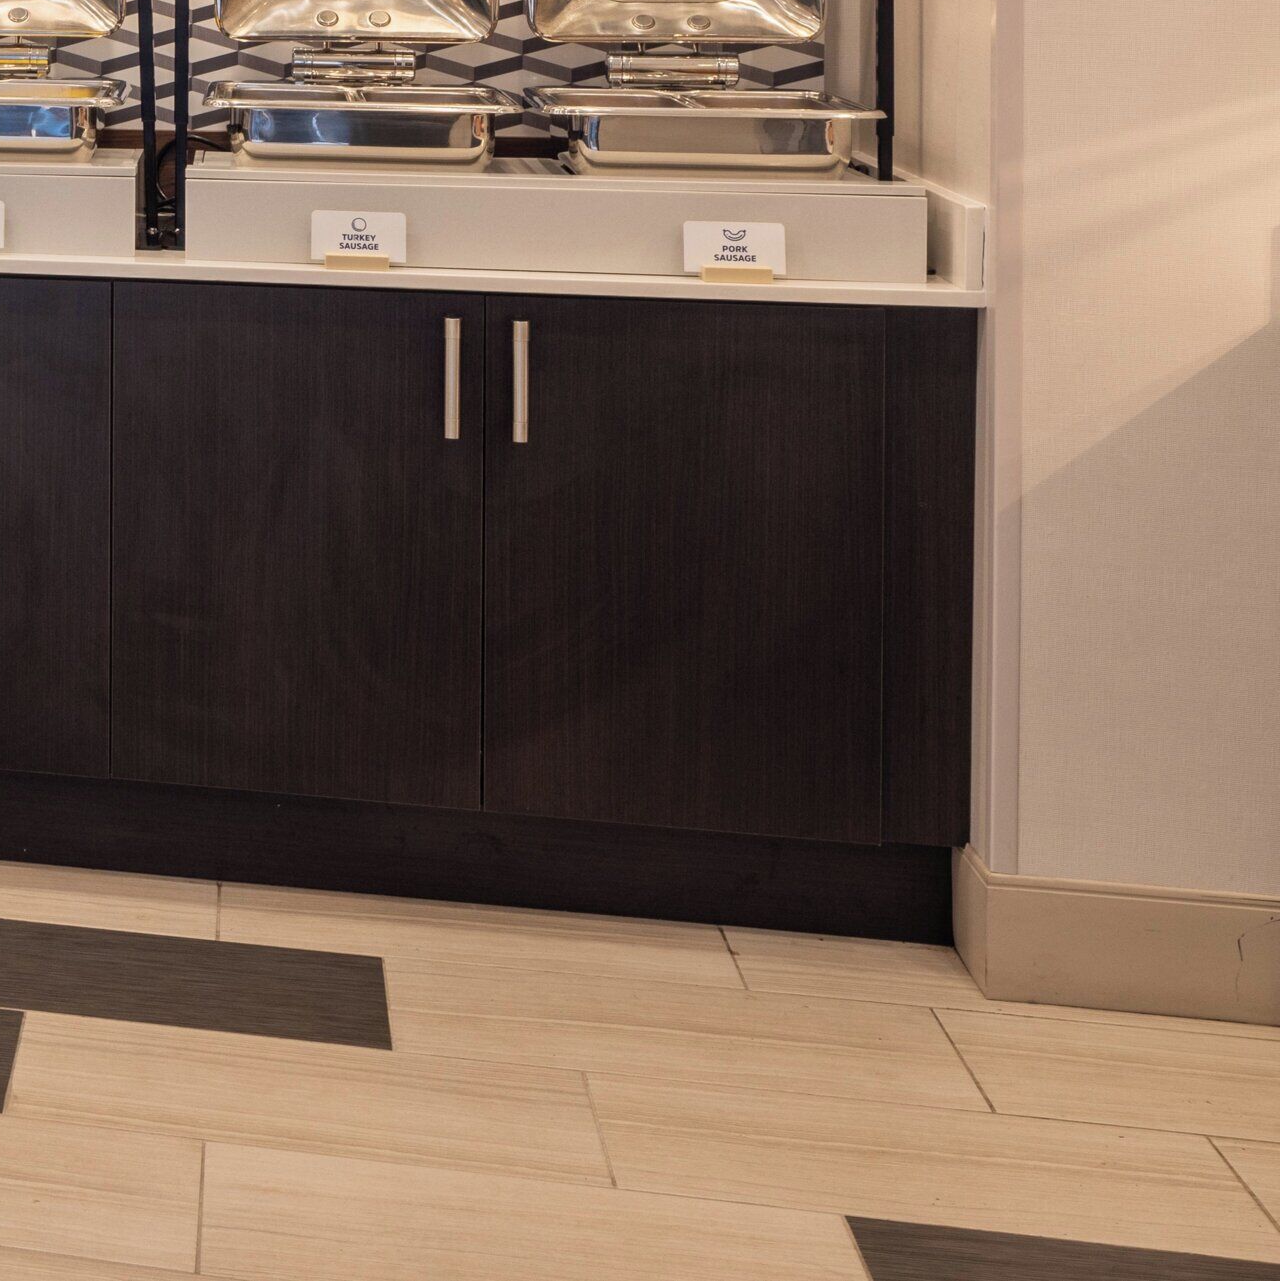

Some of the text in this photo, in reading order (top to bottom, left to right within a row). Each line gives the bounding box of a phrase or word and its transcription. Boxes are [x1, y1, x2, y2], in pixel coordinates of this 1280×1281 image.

[342, 233, 377, 242] TURKEY
[339, 242, 380, 251] SAUSAGE
[722, 245, 748, 253] PORK
[713, 253, 757, 263] SAUSAGE
